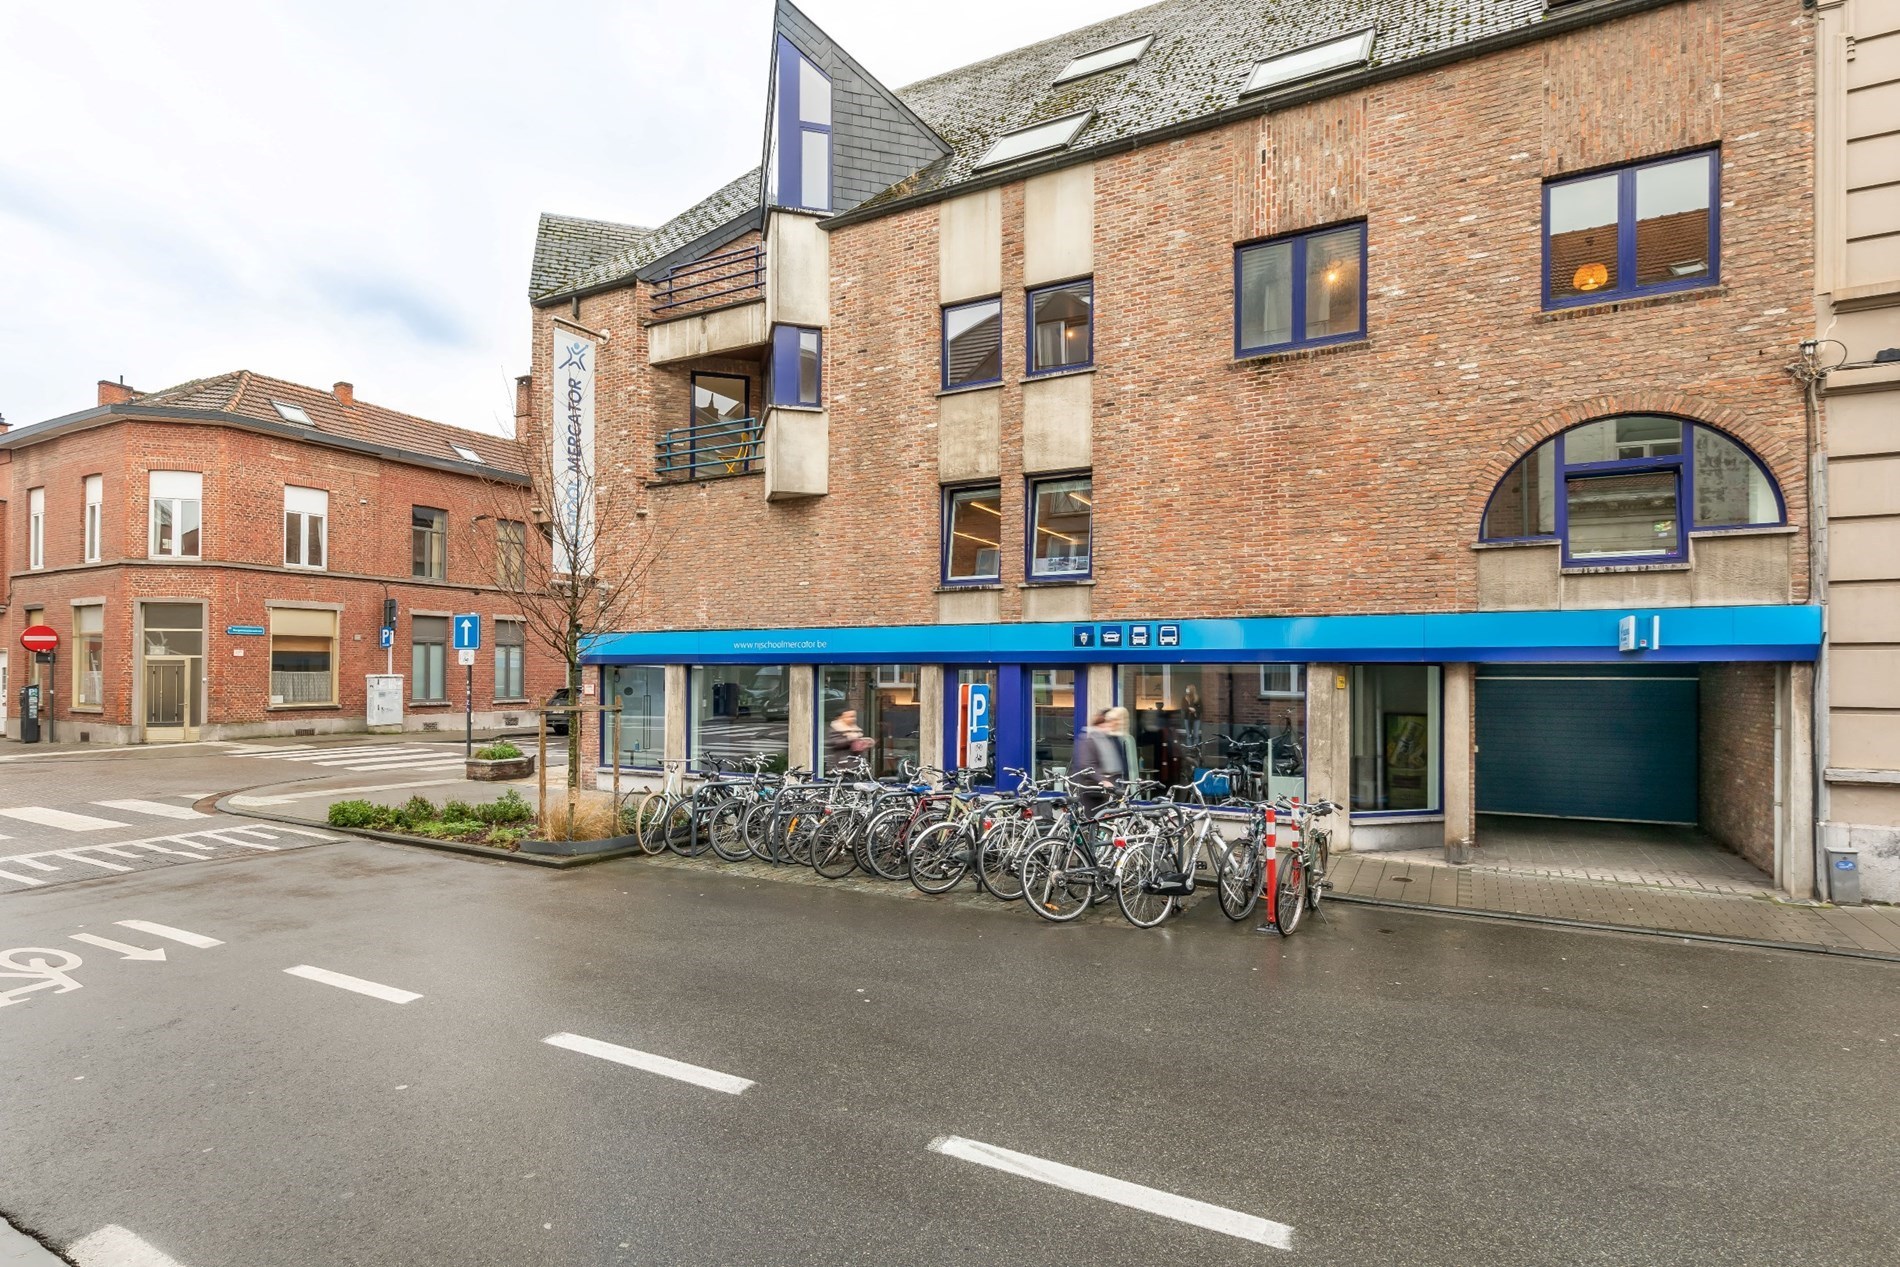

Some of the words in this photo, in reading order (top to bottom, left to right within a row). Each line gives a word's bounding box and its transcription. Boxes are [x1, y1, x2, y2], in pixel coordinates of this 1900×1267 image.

[568, 378, 583, 473] MERCATOR
[382, 629, 390, 644] P
[973, 694, 987, 733] P
